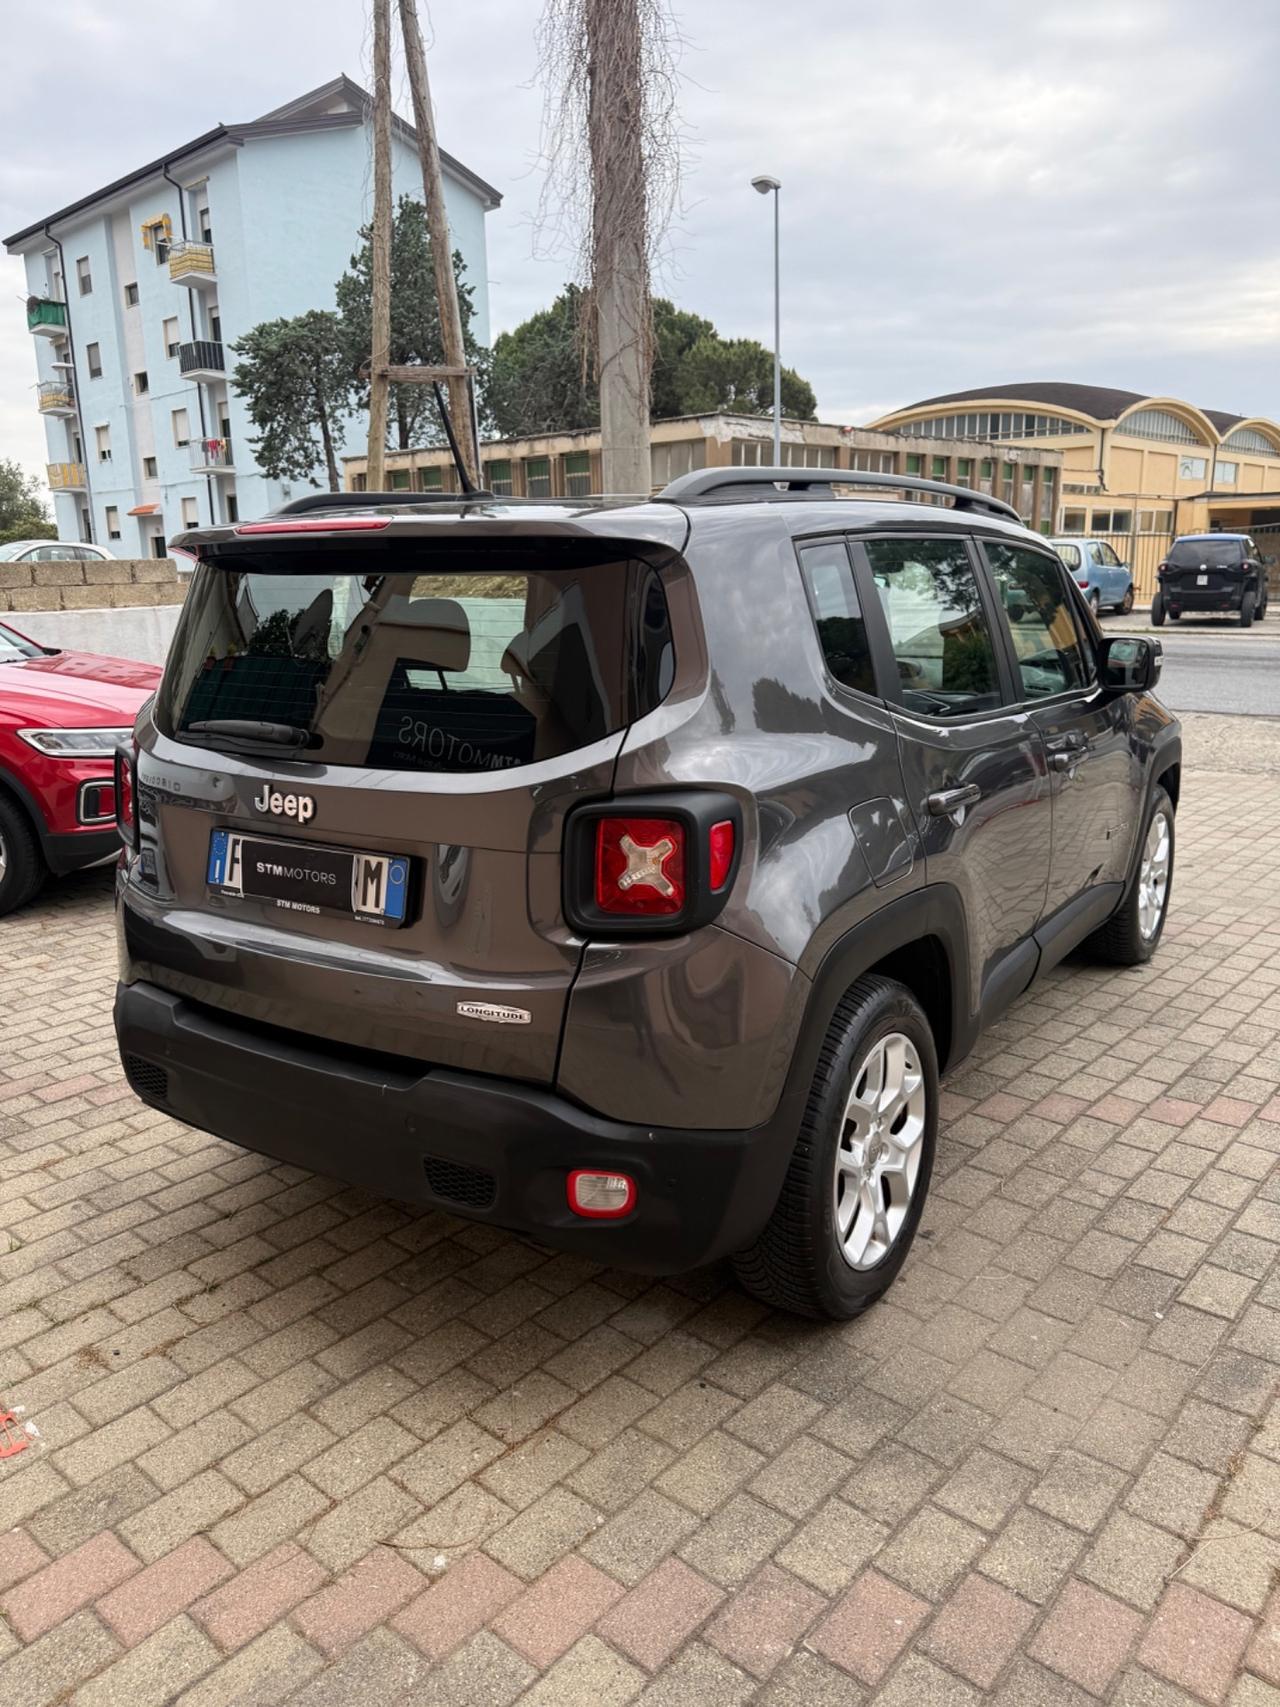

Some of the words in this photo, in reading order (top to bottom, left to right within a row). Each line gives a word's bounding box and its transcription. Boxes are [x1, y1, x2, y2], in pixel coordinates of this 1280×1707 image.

[254, 784, 314, 823] Jeep
[256, 861, 337, 885] STMMOTORS
[356, 857, 384, 909] M
[276, 899, 291, 909] STM
[291, 902, 321, 915] MOTORS
[460, 1006, 524, 1020] LONGITUDE
